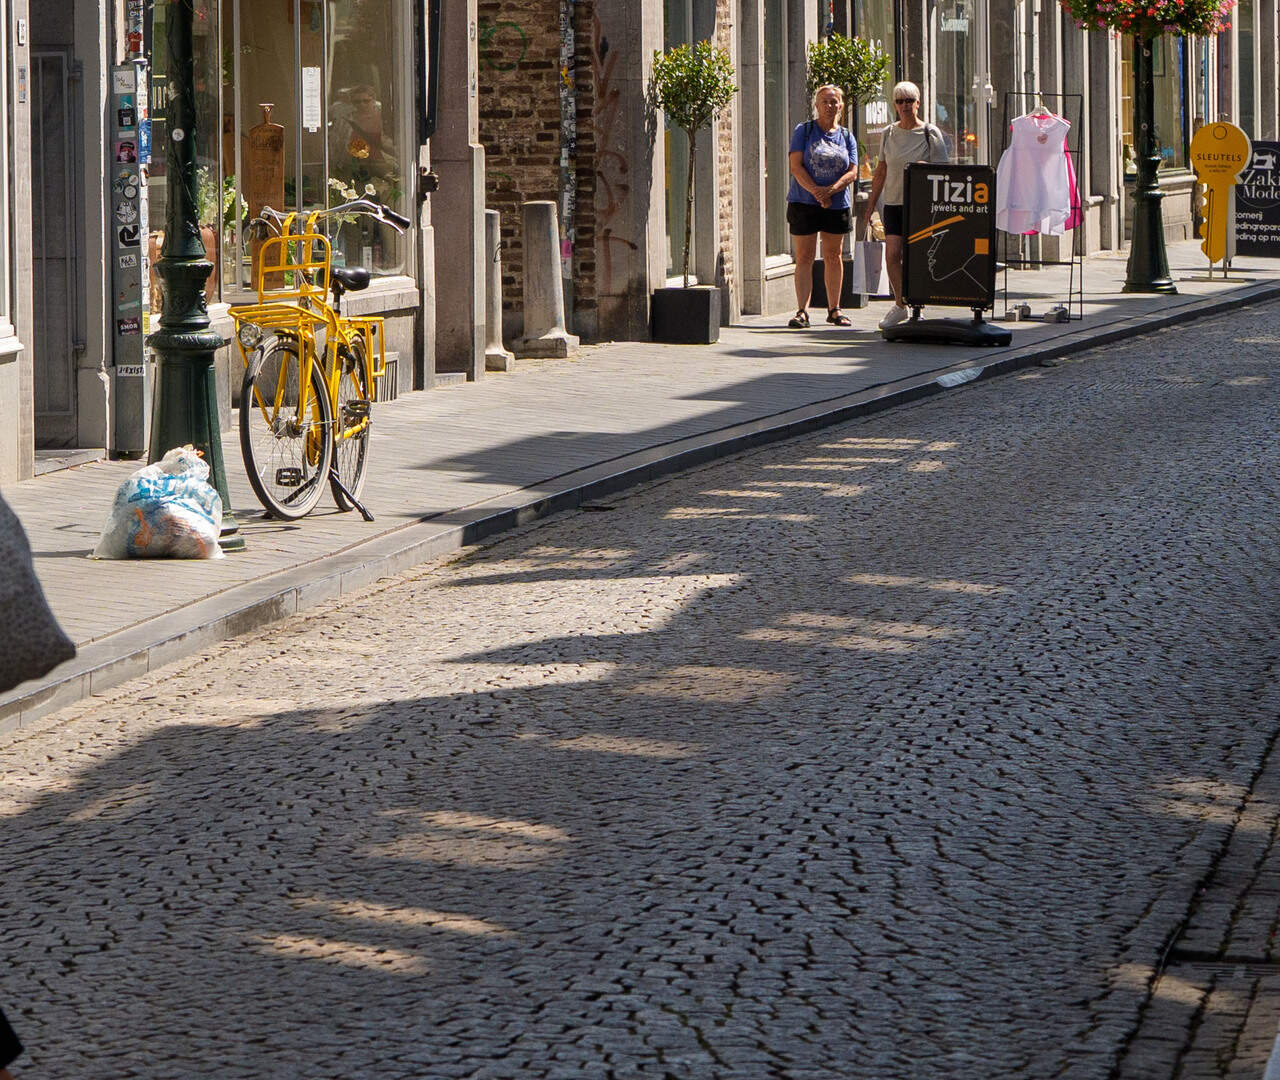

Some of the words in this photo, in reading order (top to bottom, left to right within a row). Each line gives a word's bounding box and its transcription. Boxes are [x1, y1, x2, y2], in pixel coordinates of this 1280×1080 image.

[1196, 153, 1242, 162] SLEUTELS
[927, 174, 989, 204] Tizia
[930, 203, 957, 213] jewels
[959, 204, 974, 213] and
[976, 204, 988, 214] art
[1258, 234, 1269, 243] op
